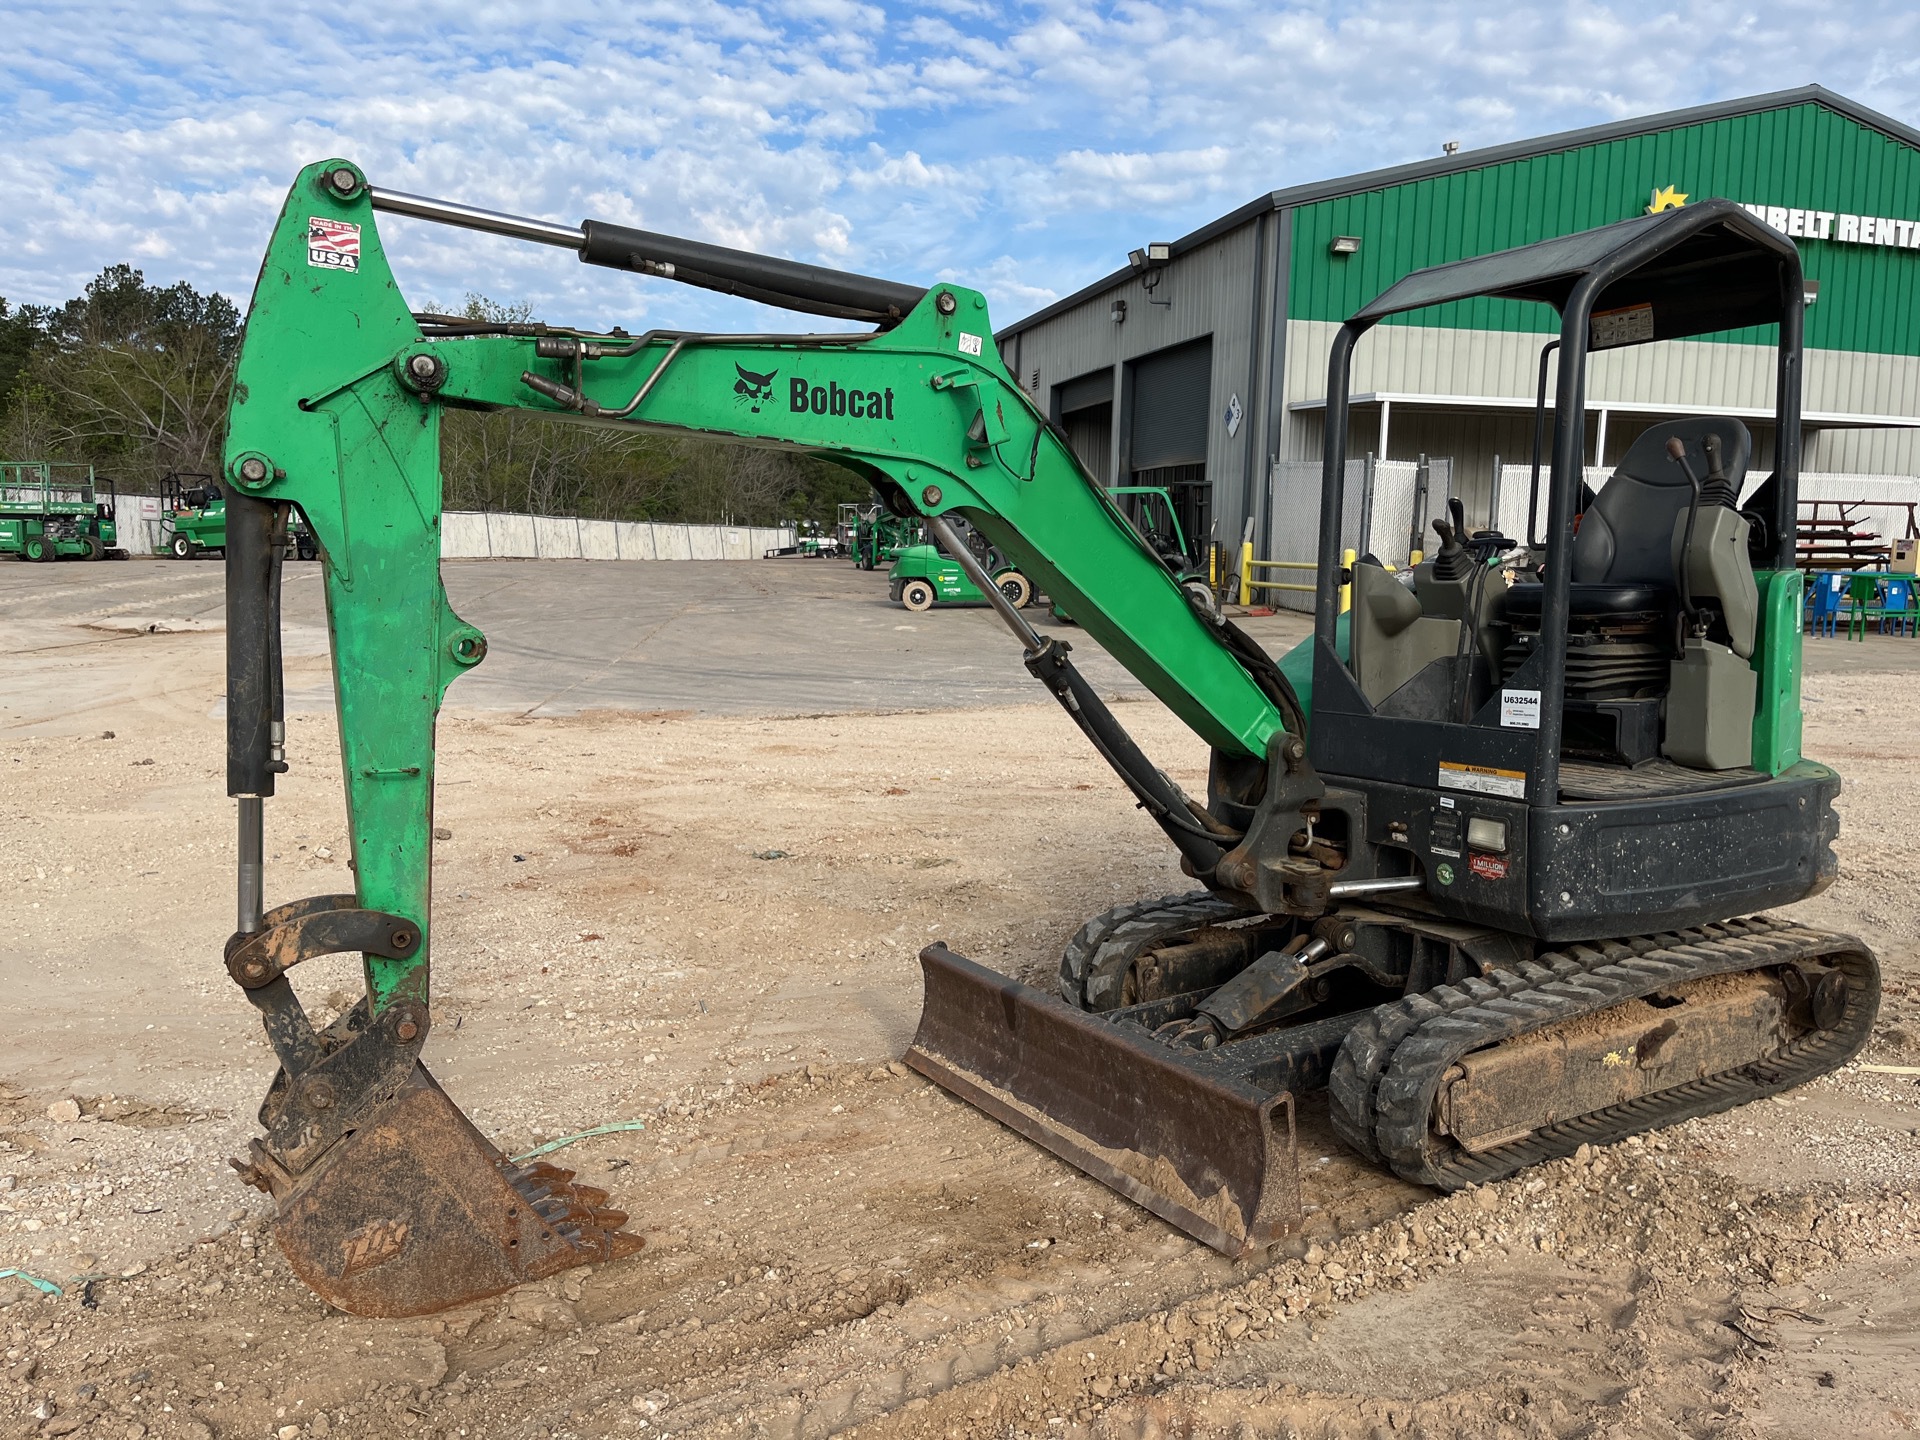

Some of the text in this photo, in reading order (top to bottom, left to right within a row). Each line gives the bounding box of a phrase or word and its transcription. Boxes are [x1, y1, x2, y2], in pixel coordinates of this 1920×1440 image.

[312, 219, 333, 228] MADE
[1737, 203, 1836, 240] BELT
[312, 250, 356, 267] USA
[789, 377, 894, 421] Bobcat
[1504, 696, 1538, 705] U632544
[1471, 766, 1498, 775] WARNING
[1477, 859, 1504, 870] MILLION
